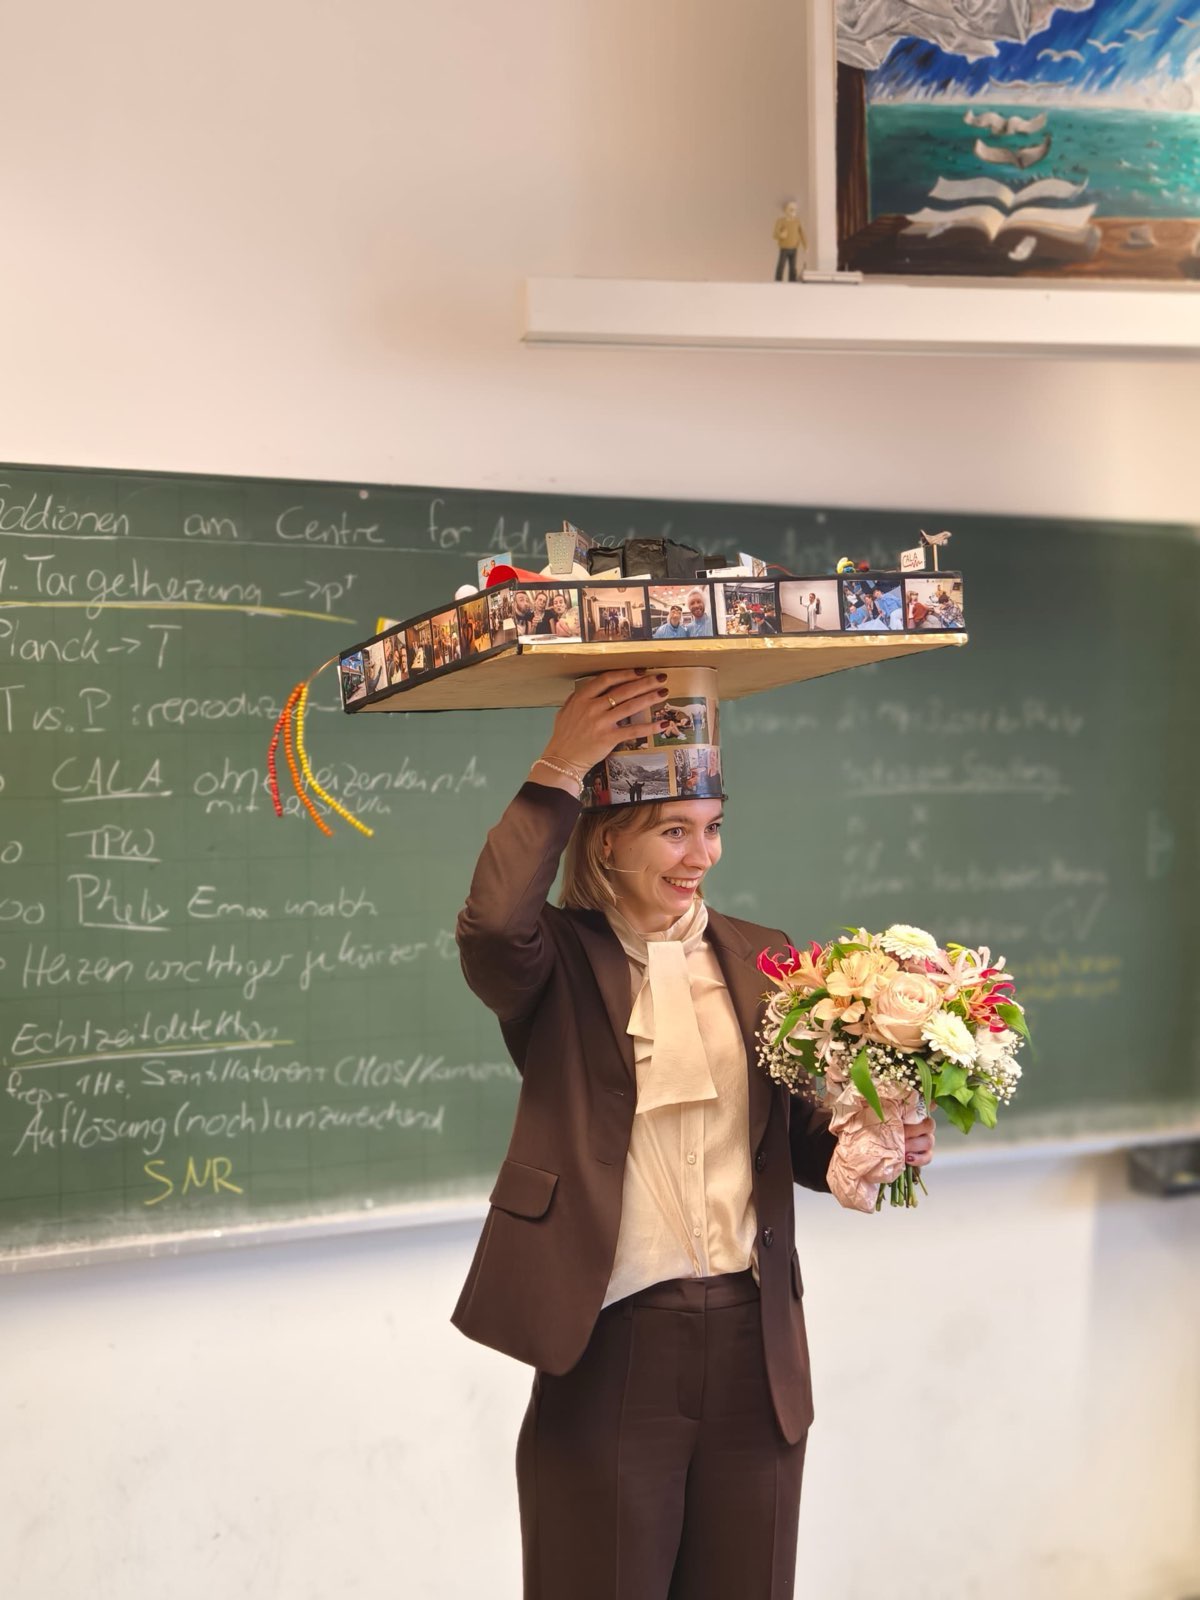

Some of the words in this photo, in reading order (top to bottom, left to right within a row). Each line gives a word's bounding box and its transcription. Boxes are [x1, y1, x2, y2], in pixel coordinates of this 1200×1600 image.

[183, 514, 238, 538] am
[276, 505, 385, 545] Centre
[426, 498, 472, 548] for
[0, 618, 99, 664] Planck
[147, 624, 182, 669] T
[79, 687, 111, 725] P
[52, 756, 164, 797] CALA
[143, 1156, 244, 1205] SNR
